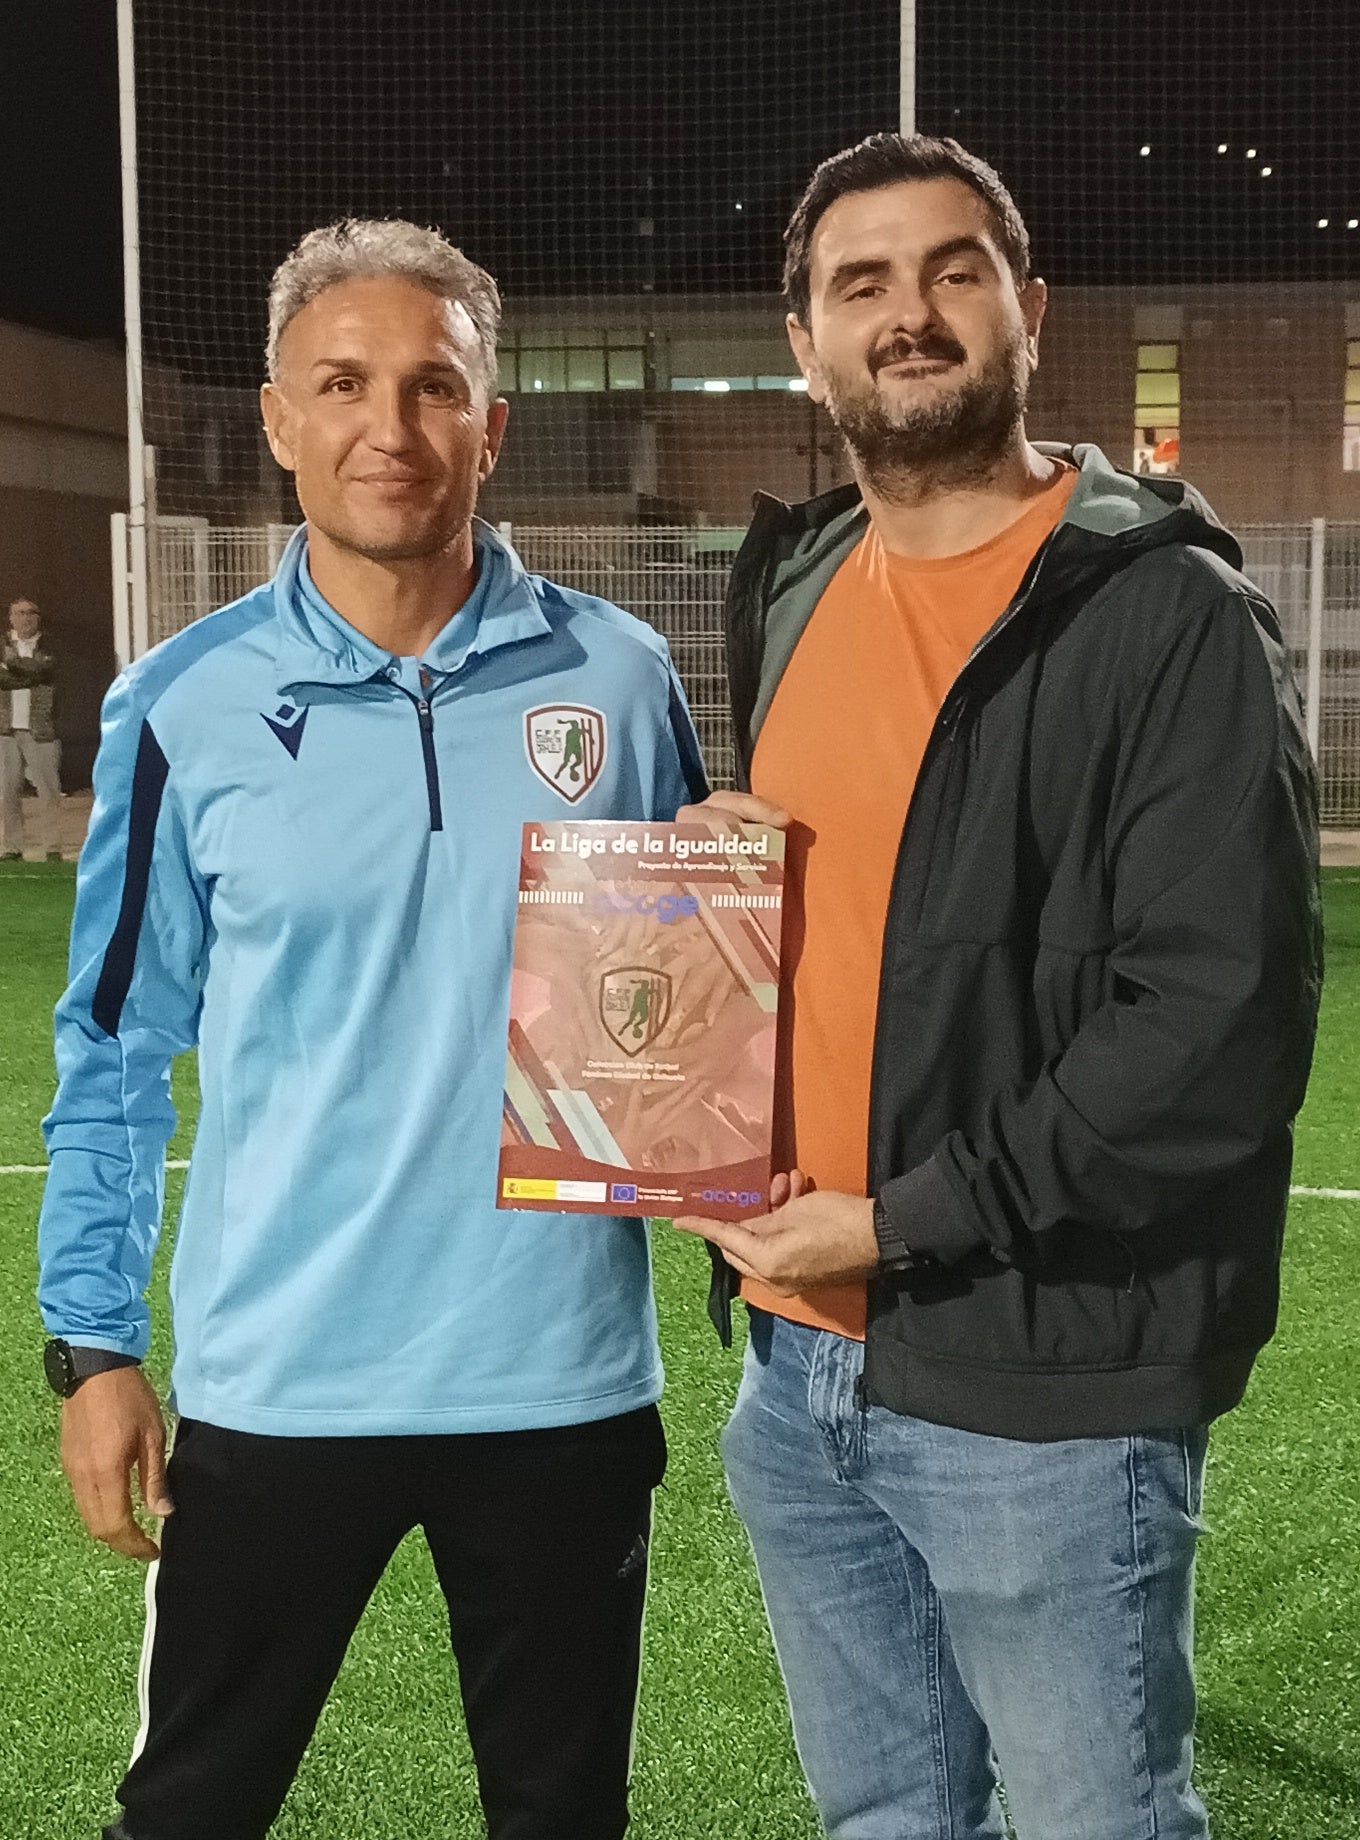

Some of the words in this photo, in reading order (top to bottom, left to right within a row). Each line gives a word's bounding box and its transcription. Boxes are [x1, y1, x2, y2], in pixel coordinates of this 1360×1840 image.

[531, 832, 556, 852] La
[560, 832, 606, 859] Liga
[611, 832, 639, 854] de
[643, 832, 664, 853] la
[669, 833, 768, 859] Igualdad
[701, 1189, 761, 1207] acoge
